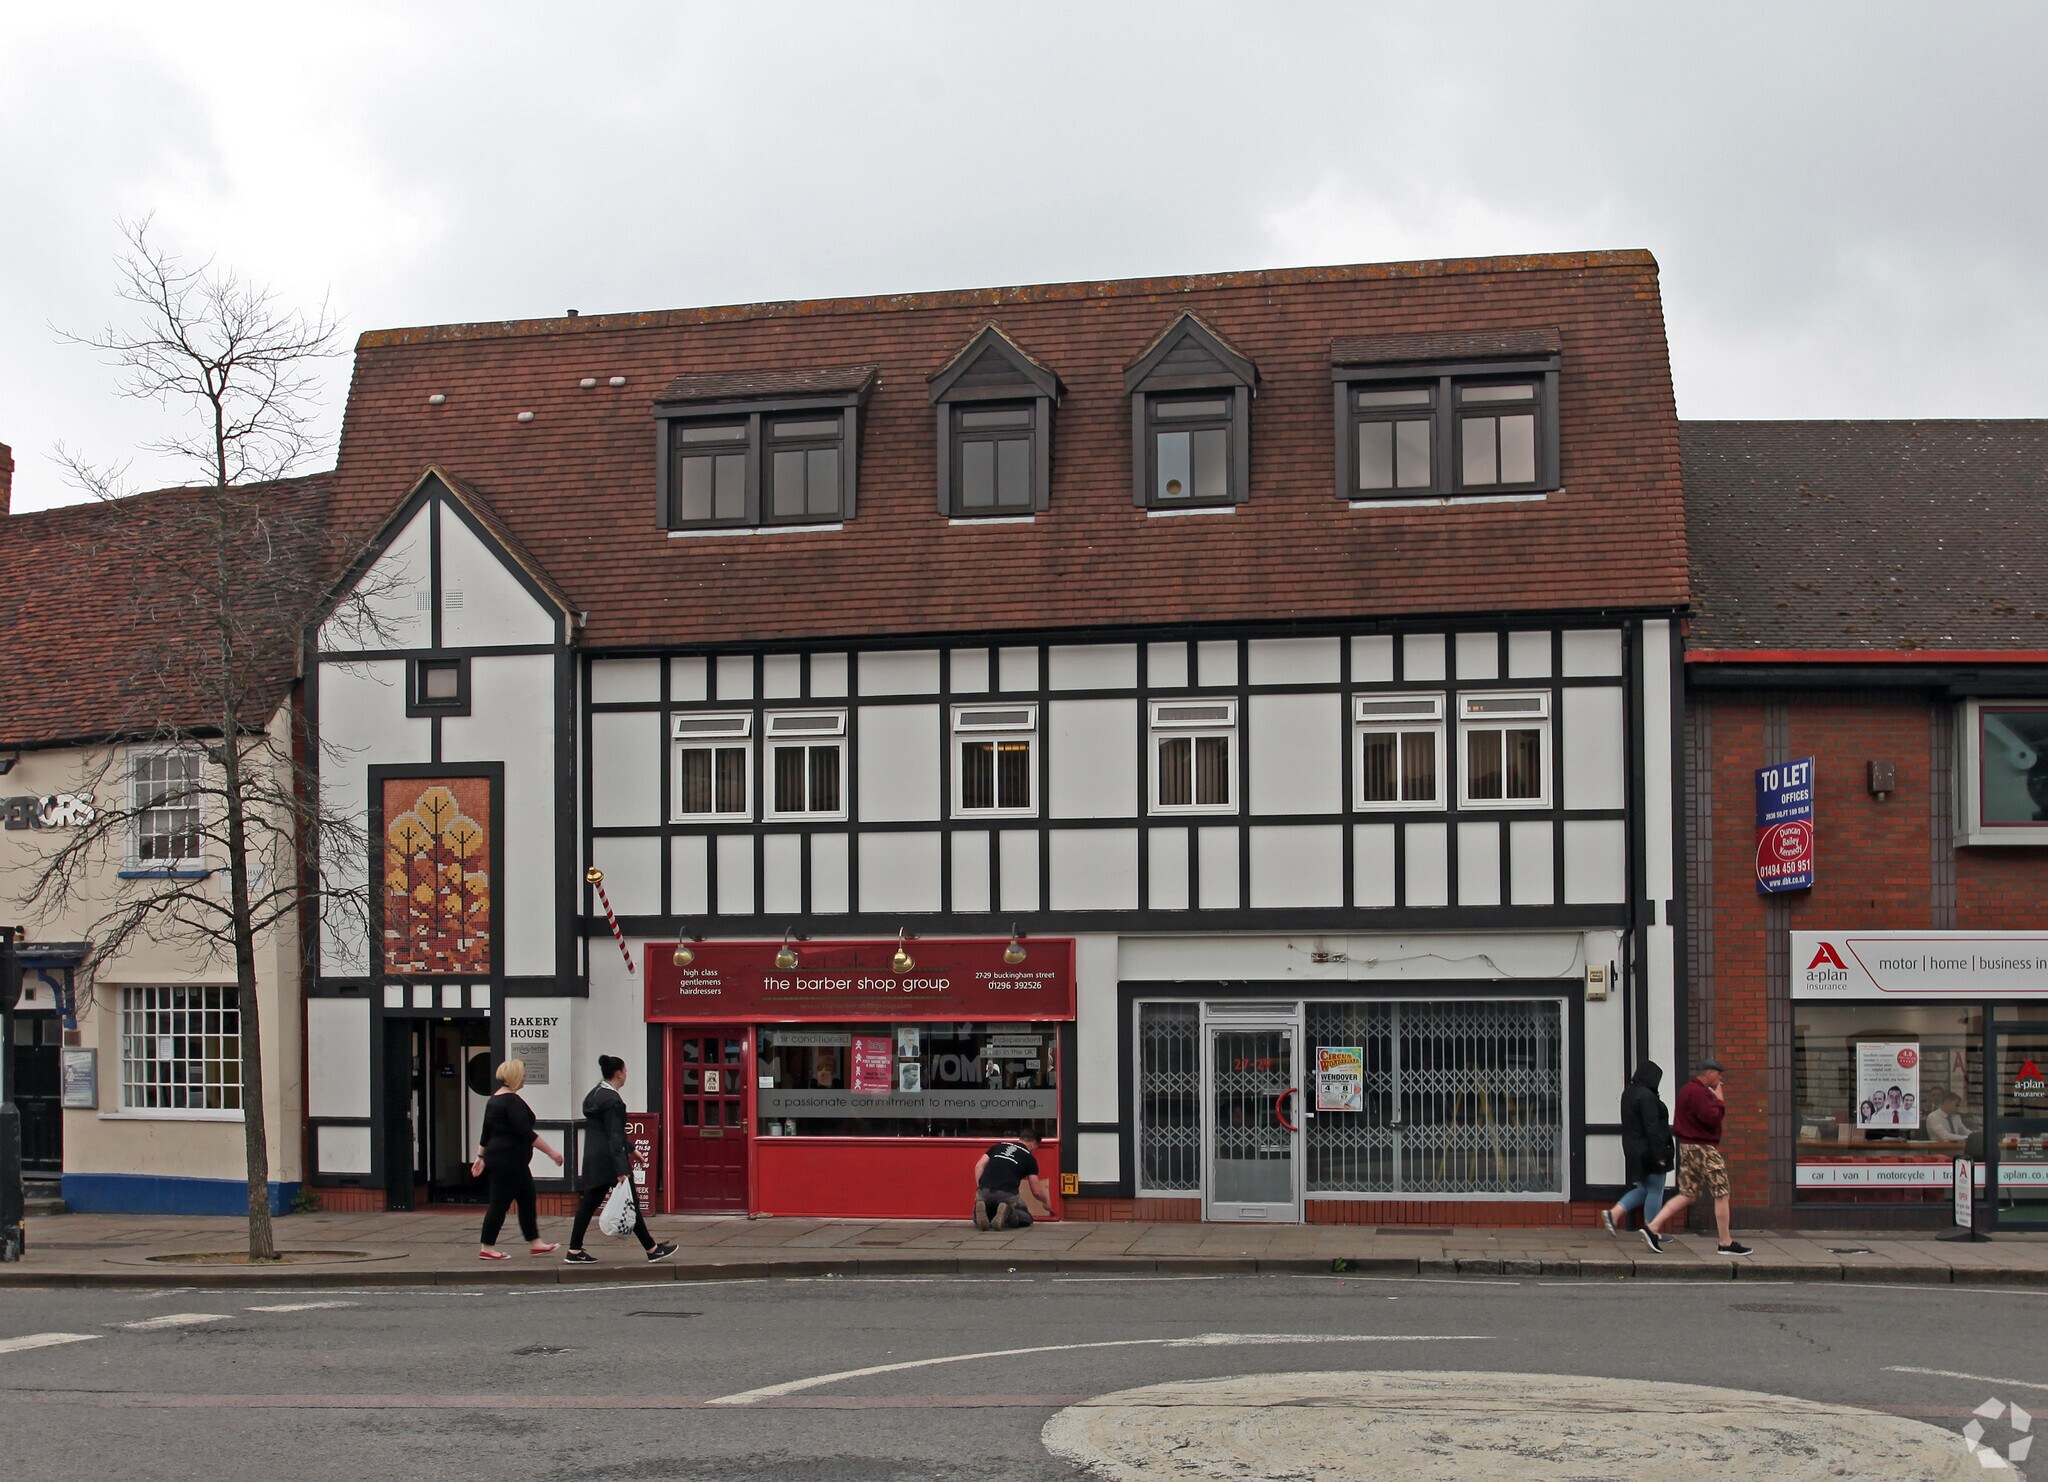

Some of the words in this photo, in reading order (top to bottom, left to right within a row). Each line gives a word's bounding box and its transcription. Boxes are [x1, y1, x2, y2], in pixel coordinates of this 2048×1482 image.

[1762, 770, 1779, 792] TO
[1783, 762, 1809, 788] LET
[1781, 789, 1809, 804] OFFICES
[0, 794, 95, 830] ERORS
[1780, 827, 1801, 838] Duncan
[1782, 836, 1800, 846] Bailey
[1779, 844, 1802, 857] Kennedy
[1760, 863, 1780, 877] 01494
[1782, 861, 1796, 874] 450
[1797, 858, 1810, 872] 951
[1879, 958, 1918, 970] motor
[1930, 956, 1968, 970] home
[1980, 956, 2032, 970] business
[683, 969, 699, 978] high
[993, 972, 1034, 980] buckingham
[1806, 969, 1848, 983] a-plan
[680, 978, 722, 988] gentlemens
[764, 977, 791, 990] the
[796, 977, 852, 990] barber
[857, 977, 897, 992] shop
[902, 978, 951, 993] group
[988, 981, 1012, 990] 01296
[1014, 981, 1042, 990] 392526
[679, 987, 722, 995] hairdressers
[509, 1016, 559, 1027] BAKERY
[509, 1028, 549, 1039] HOUSE
[778, 1034, 789, 1043] air
[791, 1033, 850, 1044] conditioned
[994, 1035, 1041, 1045] independent
[772, 1099, 780, 1107] a
[784, 1097, 847, 1108] passionate
[851, 1097, 924, 1107] commitment
[929, 1098, 940, 1107] to
[944, 1099, 976, 1107] mens
[1876, 1170, 1925, 1182] motorcycle
